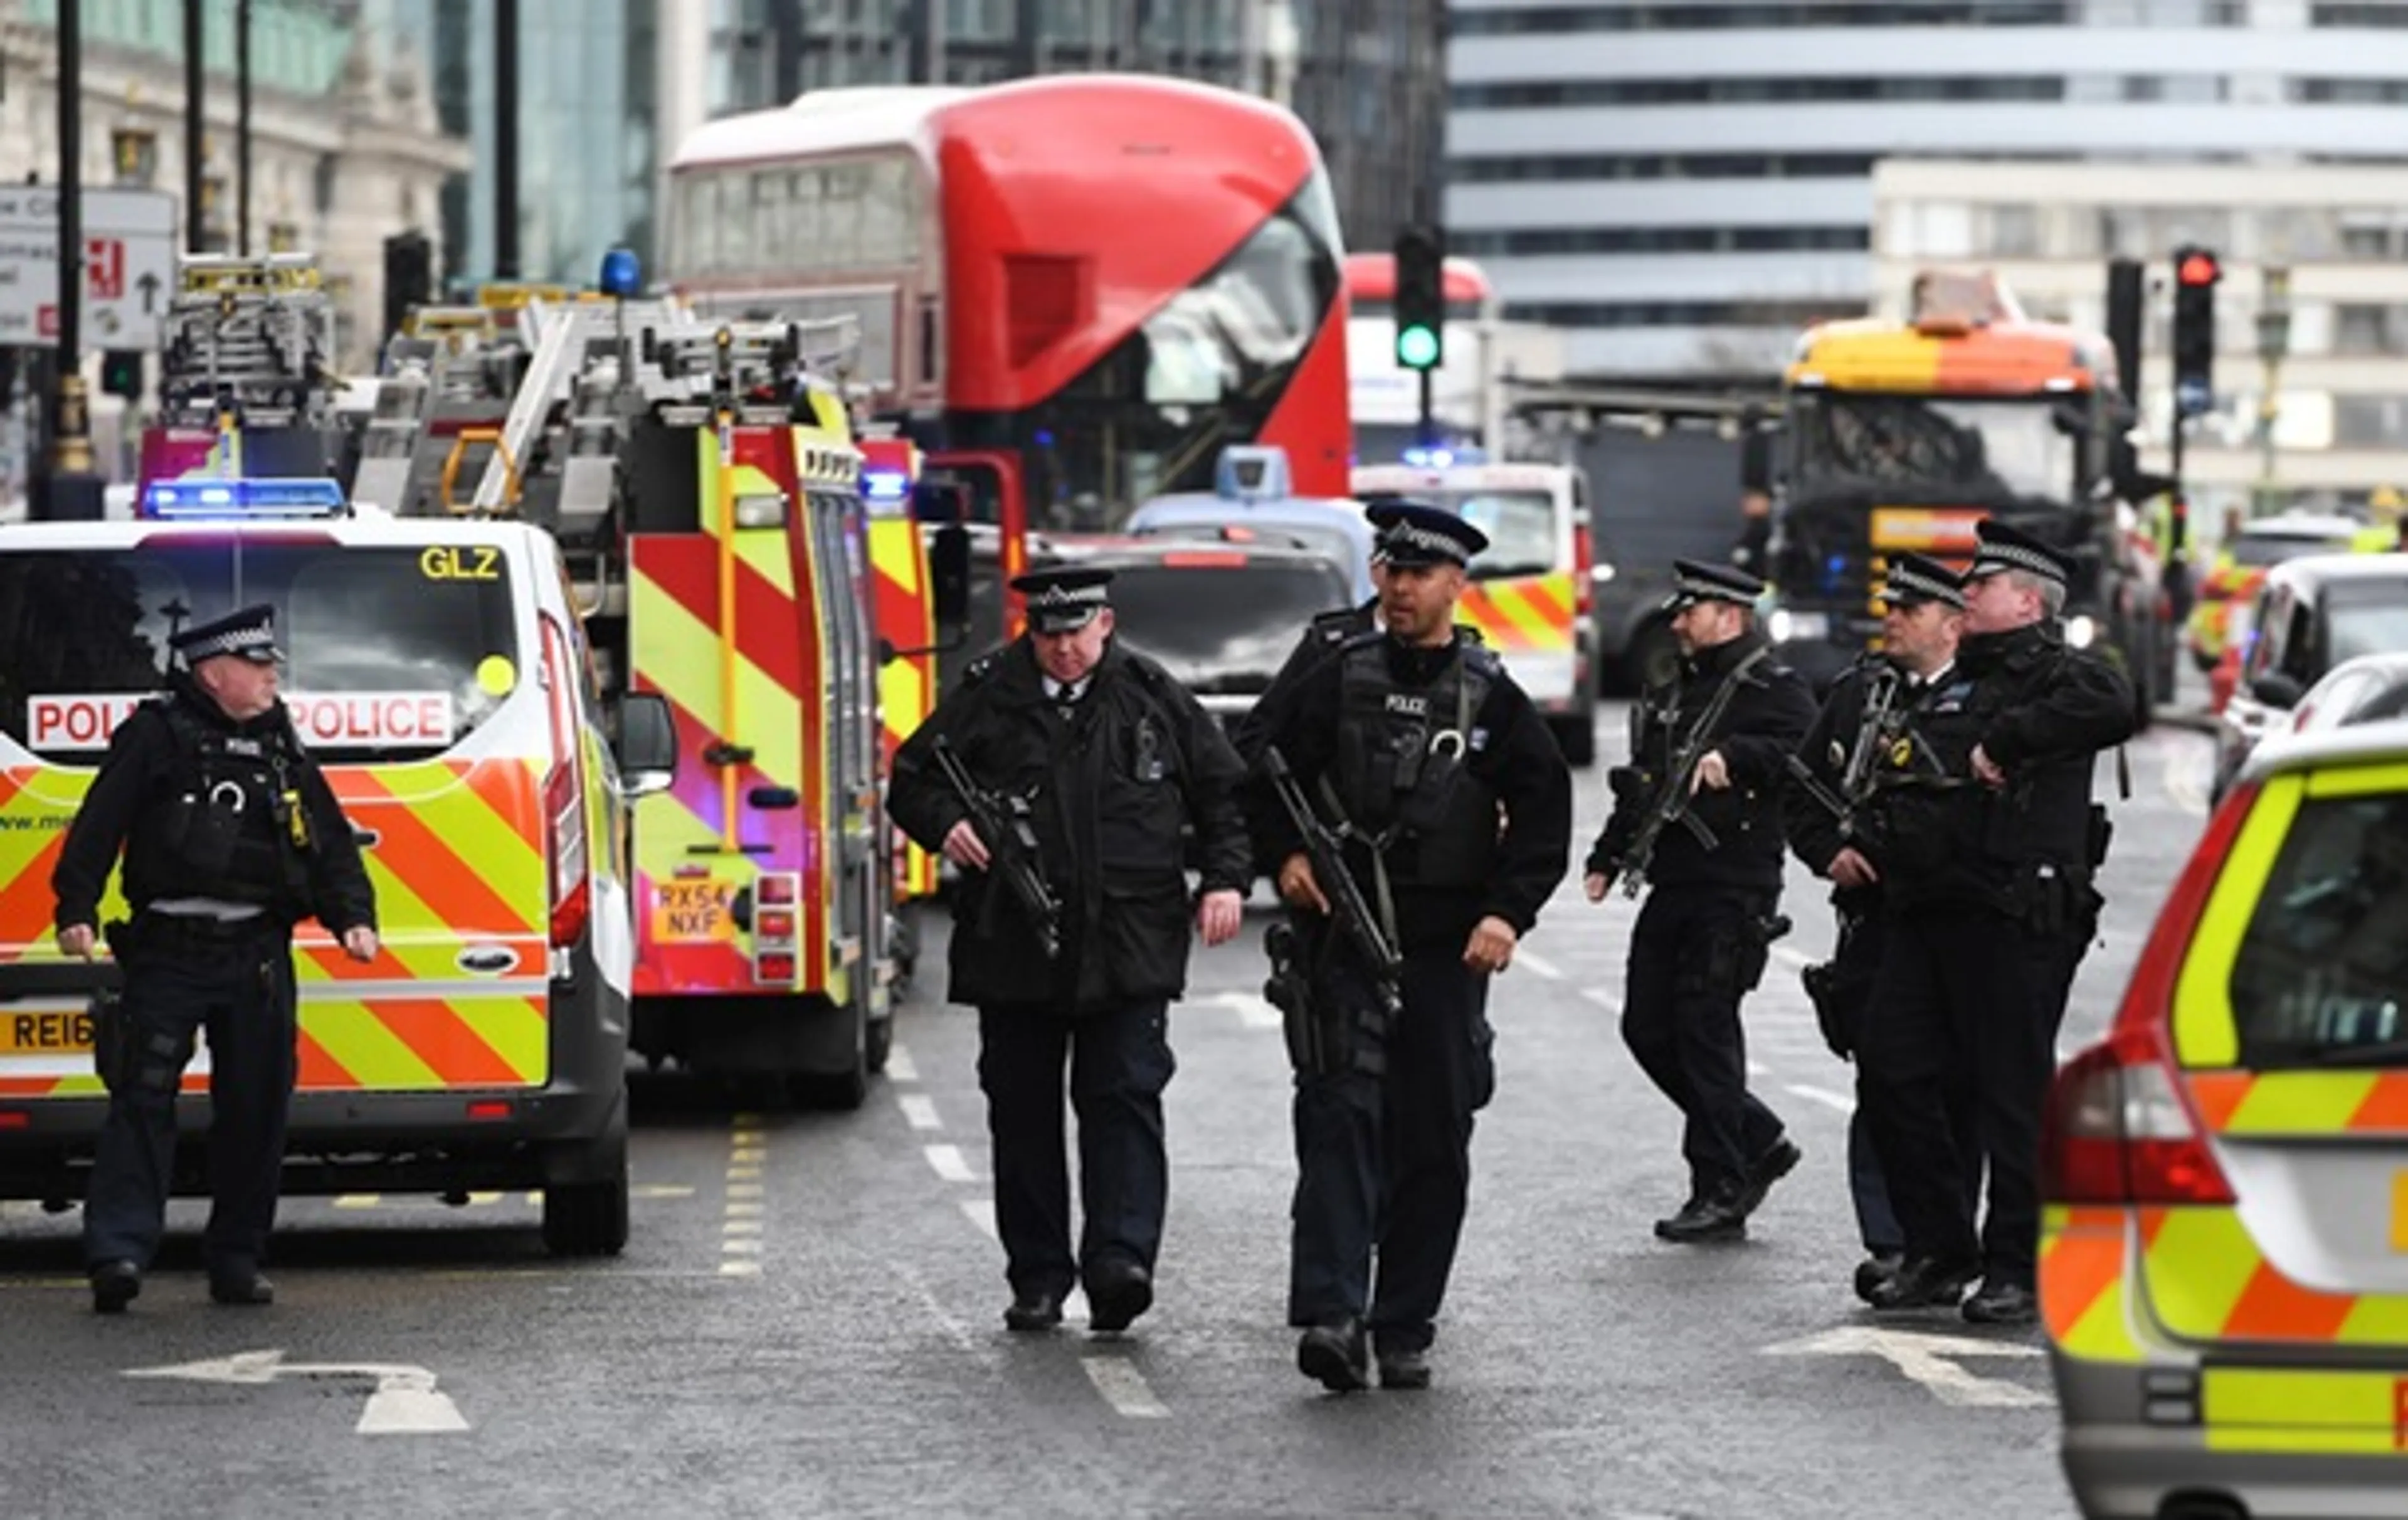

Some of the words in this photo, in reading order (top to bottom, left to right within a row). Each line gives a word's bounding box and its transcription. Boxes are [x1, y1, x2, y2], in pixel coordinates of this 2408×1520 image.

[421, 546, 499, 578] GLZ
[36, 702, 137, 742] POL
[658, 884, 727, 909] RX54
[667, 910, 719, 935] NXF
[15, 1013, 98, 1047] RE16
